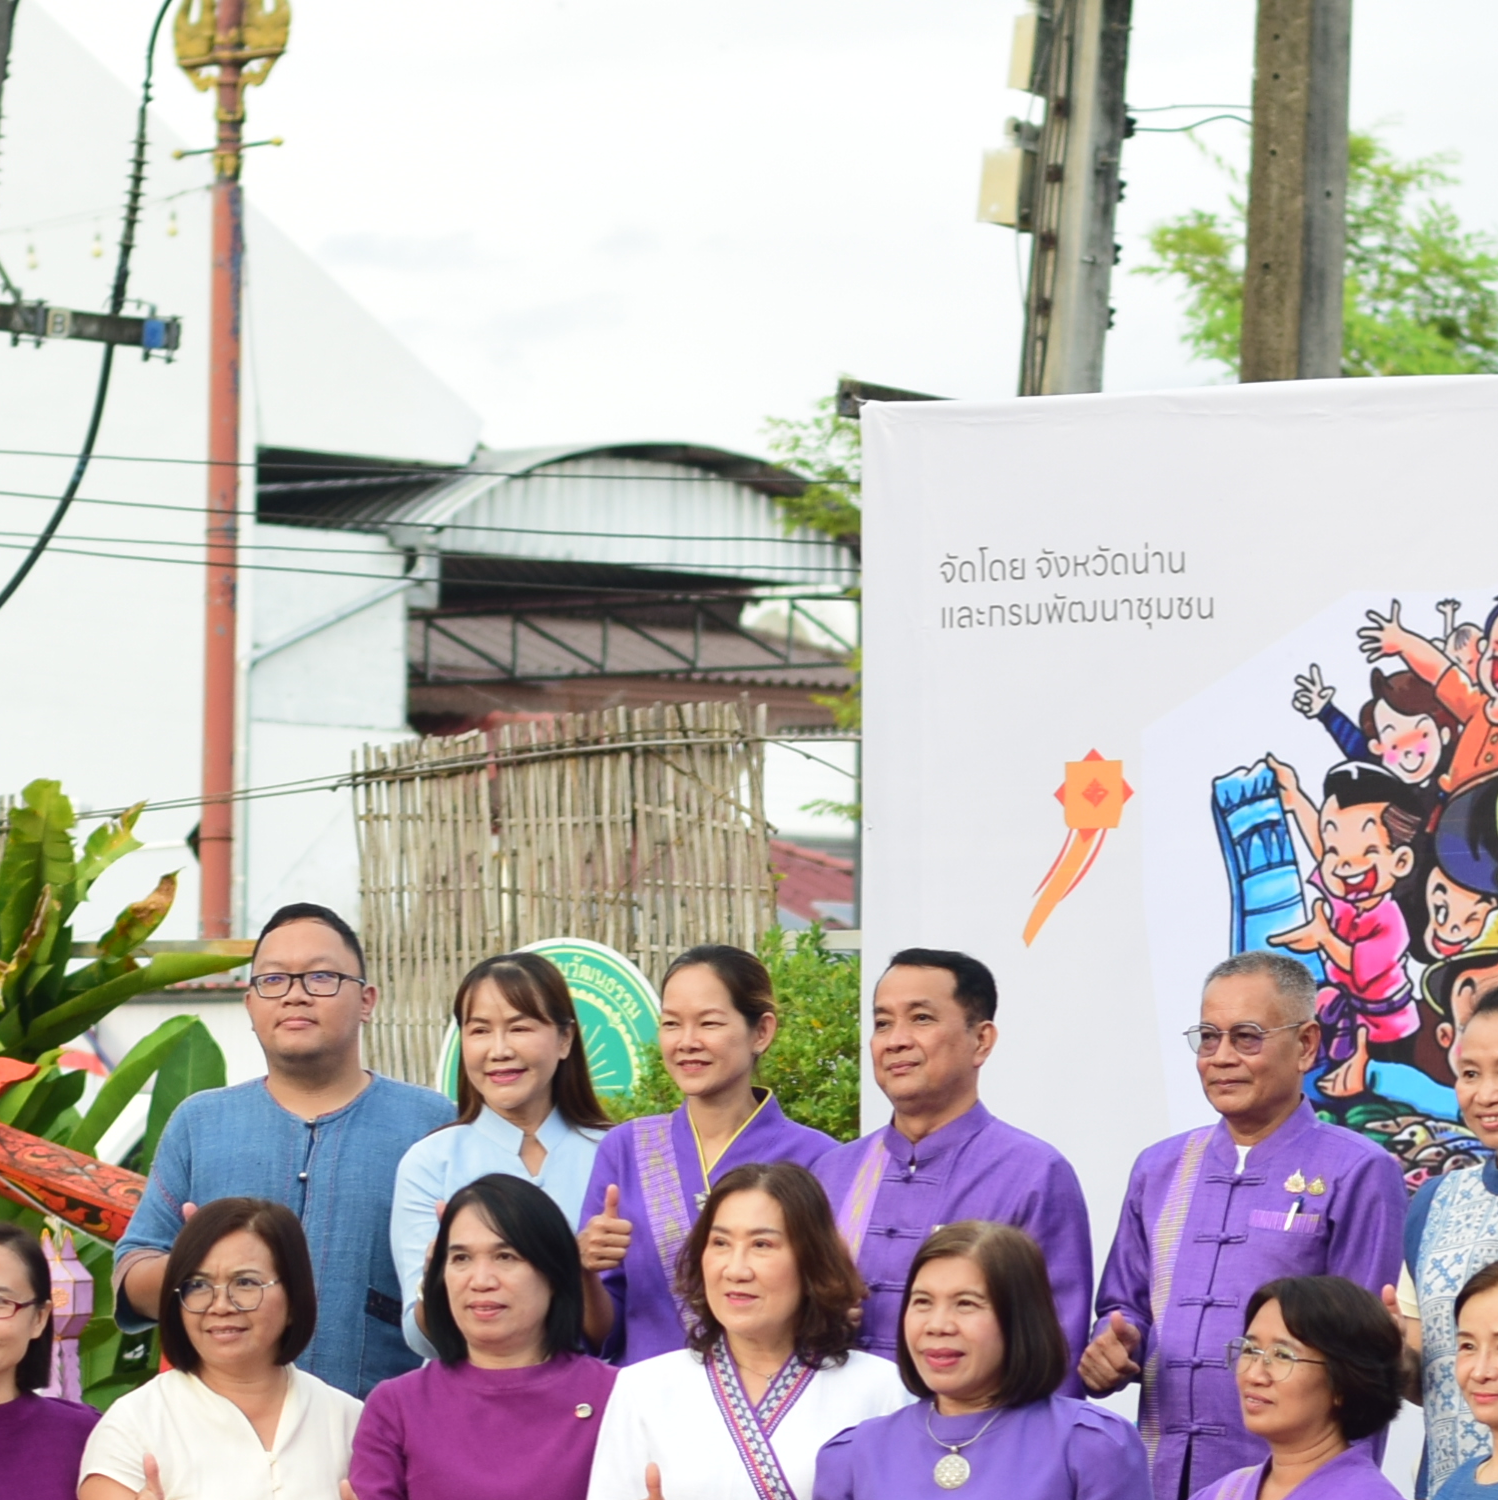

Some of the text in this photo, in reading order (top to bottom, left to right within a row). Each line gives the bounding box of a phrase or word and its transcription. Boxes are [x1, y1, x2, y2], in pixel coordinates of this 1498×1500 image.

[939, 542, 1186, 583] จัดโดย จังหวัดน่าน
[941, 593, 1214, 630] และกรมพัฒนาชุมชน
